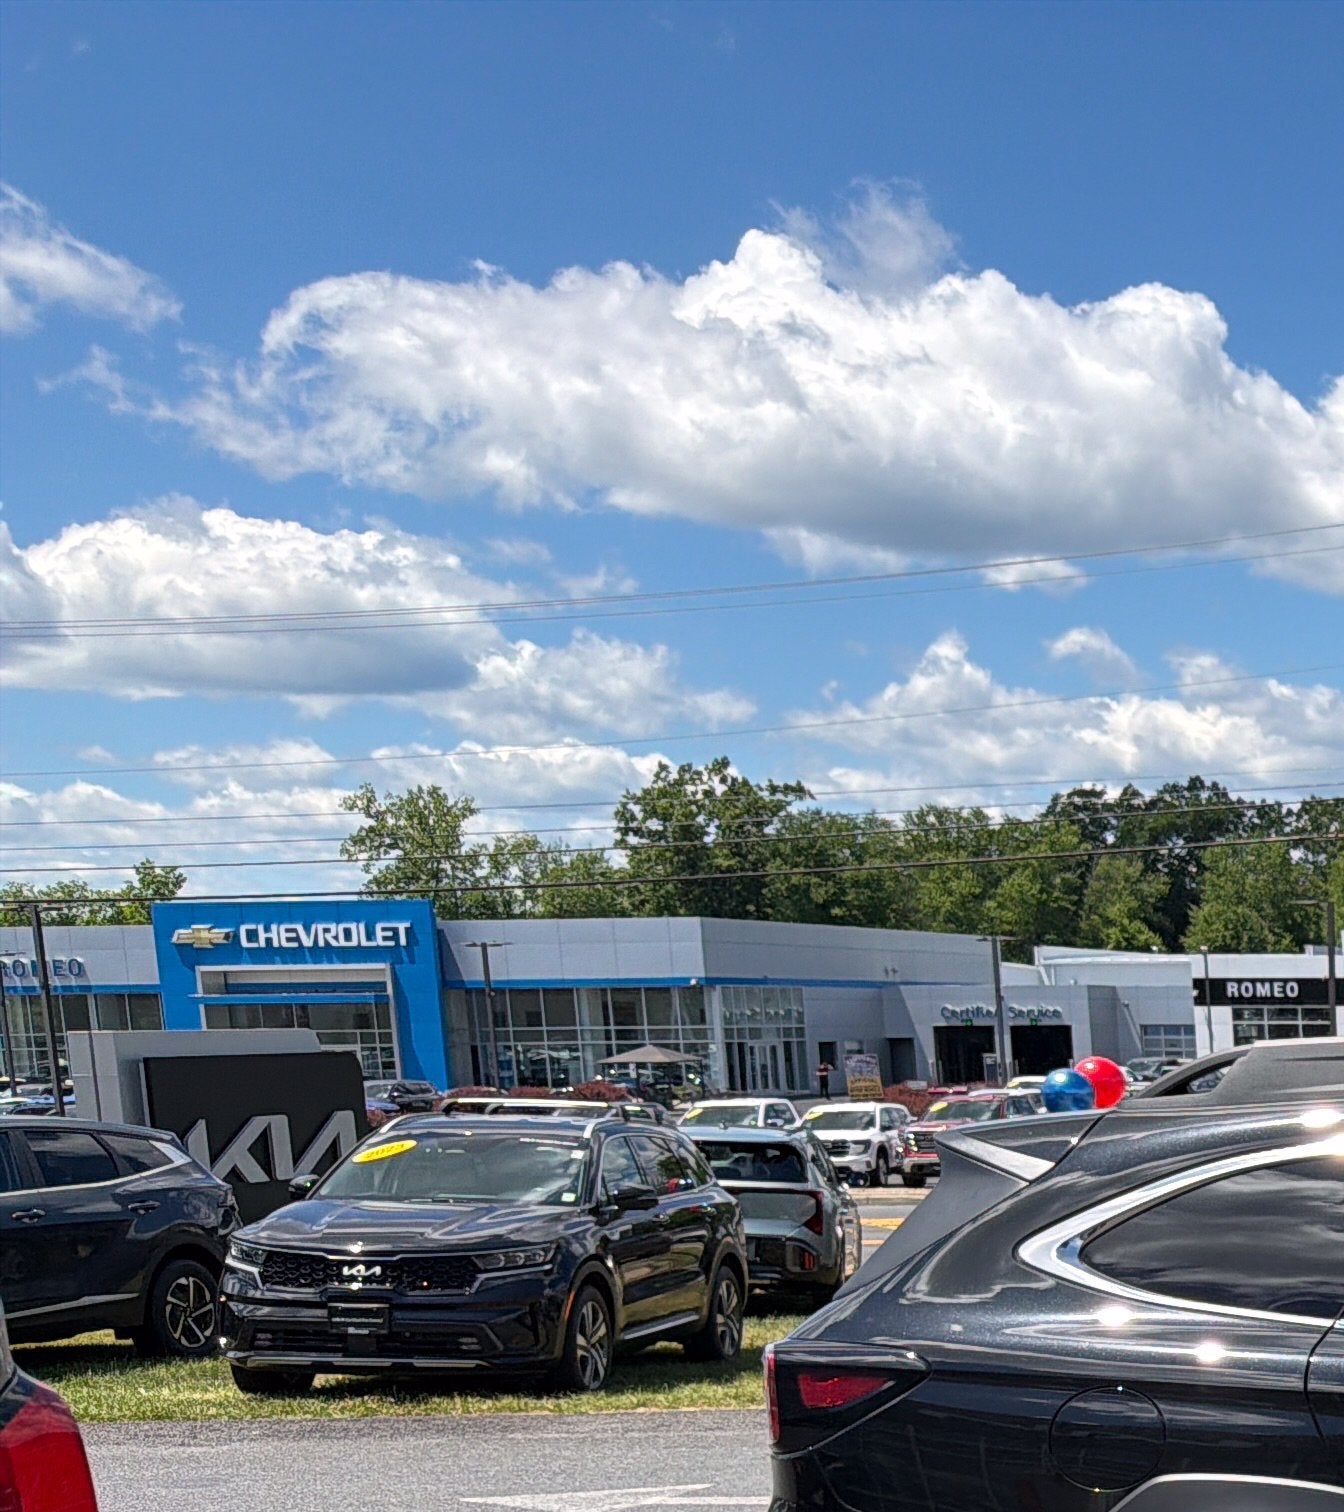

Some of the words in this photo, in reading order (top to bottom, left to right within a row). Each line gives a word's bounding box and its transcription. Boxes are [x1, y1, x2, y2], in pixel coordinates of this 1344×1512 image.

[239, 921, 412, 948] CHEVROLET
[1226, 981, 1299, 998] ROMEO
[940, 1005, 998, 1020] Certifie
[1008, 1005, 1063, 1019] Service
